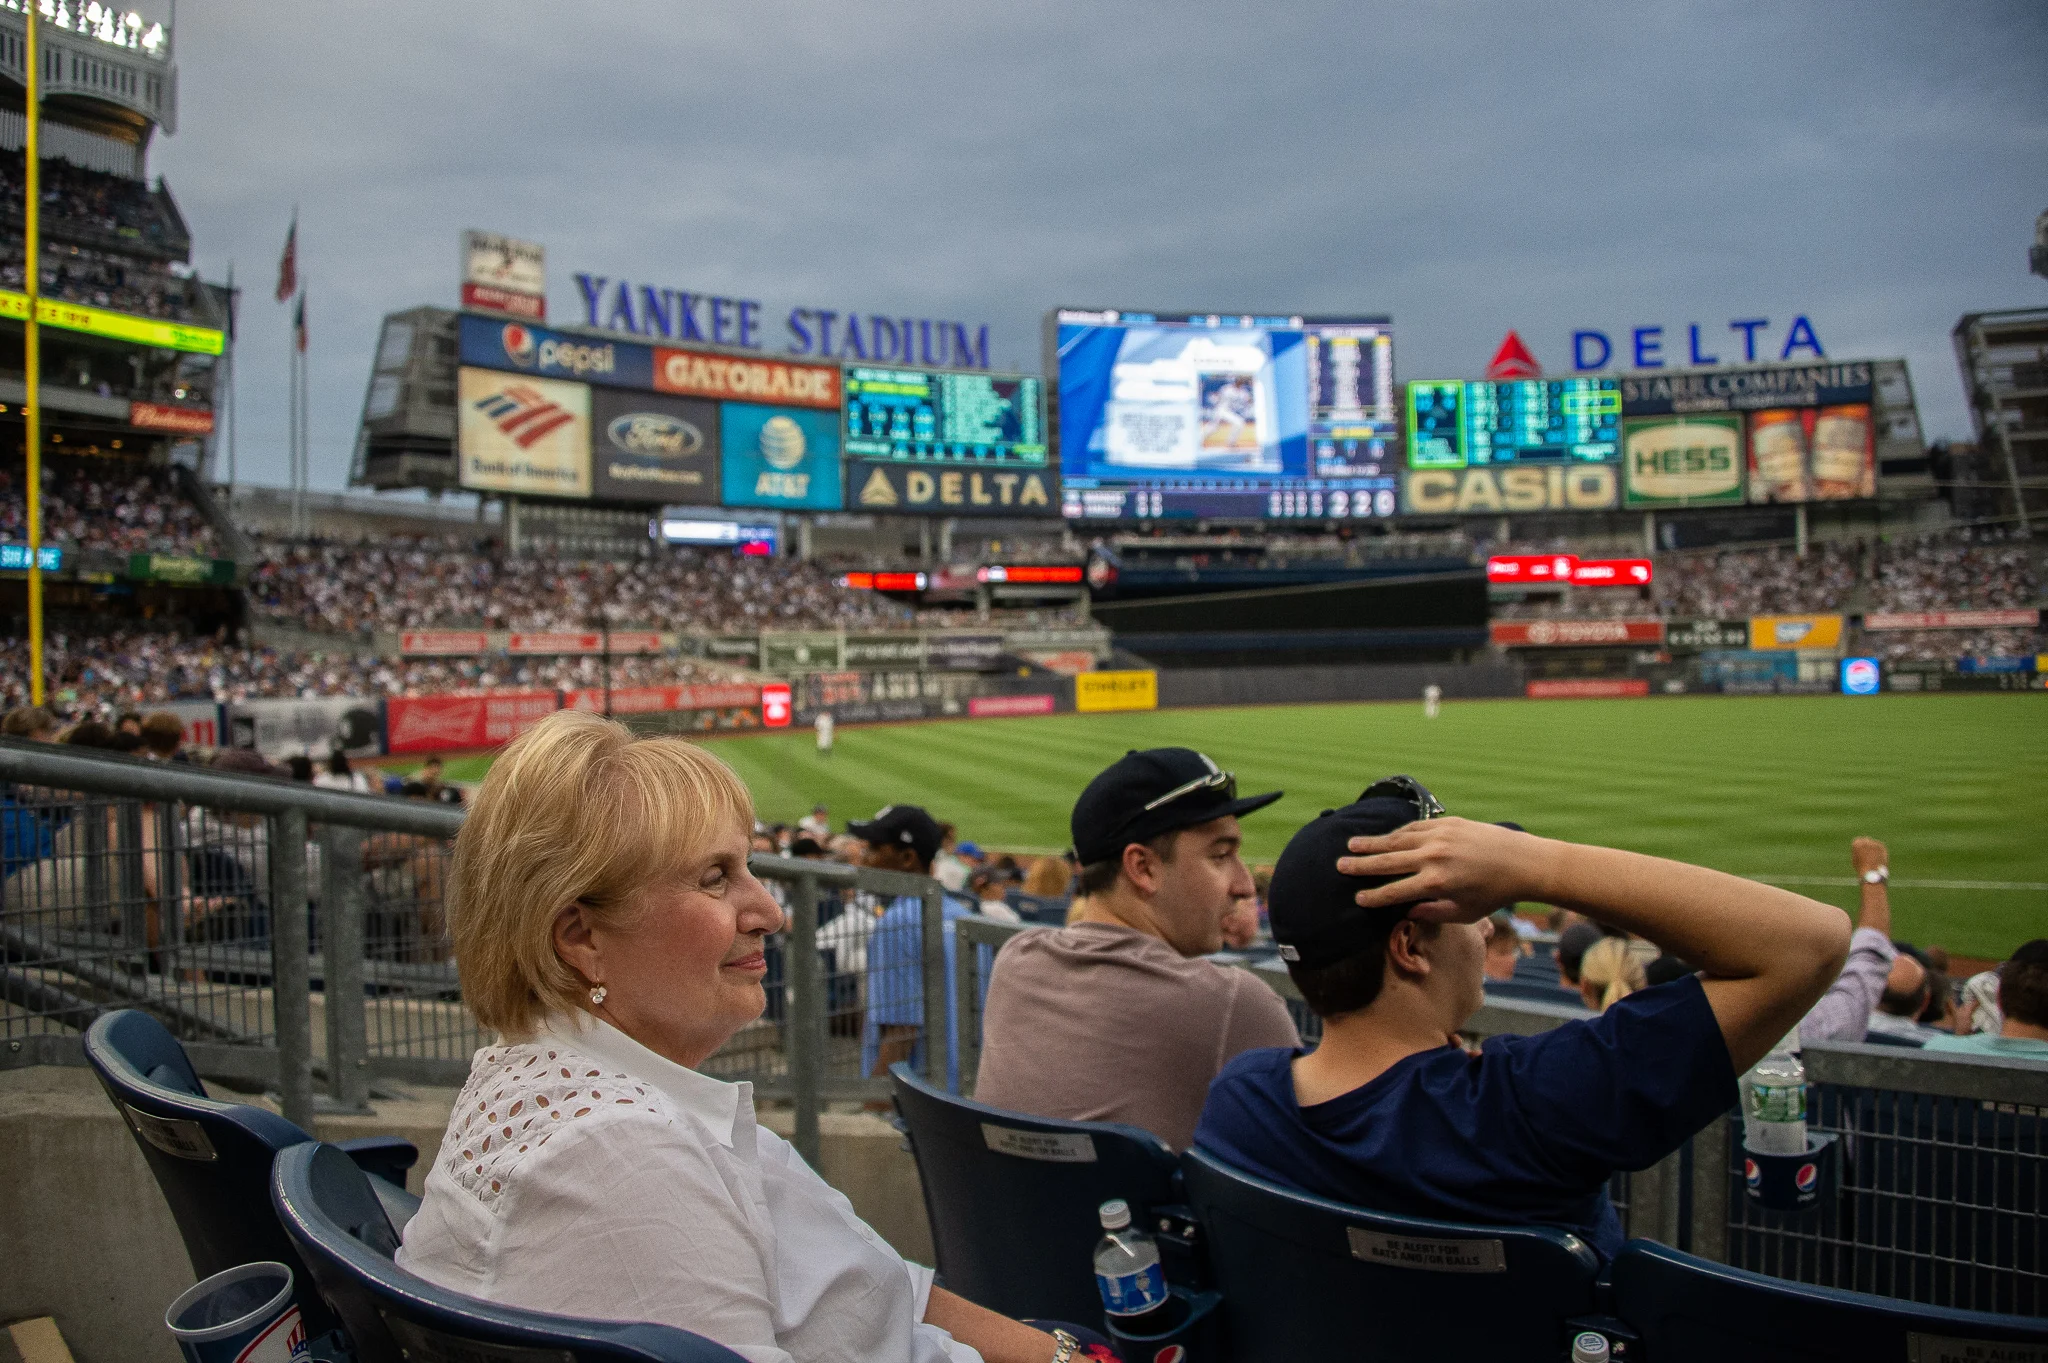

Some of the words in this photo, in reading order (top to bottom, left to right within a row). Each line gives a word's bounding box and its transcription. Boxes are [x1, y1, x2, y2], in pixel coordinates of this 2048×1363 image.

[575, 273, 761, 349] YANKEE
[786, 306, 990, 369] STADIUM
[539, 339, 615, 376] pepsi
[1572, 315, 1825, 371] DELTA
[665, 355, 832, 400] GATORADE
[1635, 445, 1731, 476] HESS
[755, 472, 810, 497] AT&T
[906, 470, 1049, 505] DELTA
[1407, 466, 1617, 513] CASIO
[1329, 490, 1349, 517] 2
[1351, 490, 1372, 517] 2
[1372, 1247, 1396, 1259] BATS
[1447, 1256, 1480, 1266] BALLS
[1387, 1240, 1399, 1249] BE
[1404, 1241, 1435, 1252] ALERT
[1438, 1244, 1459, 1254] FOR
